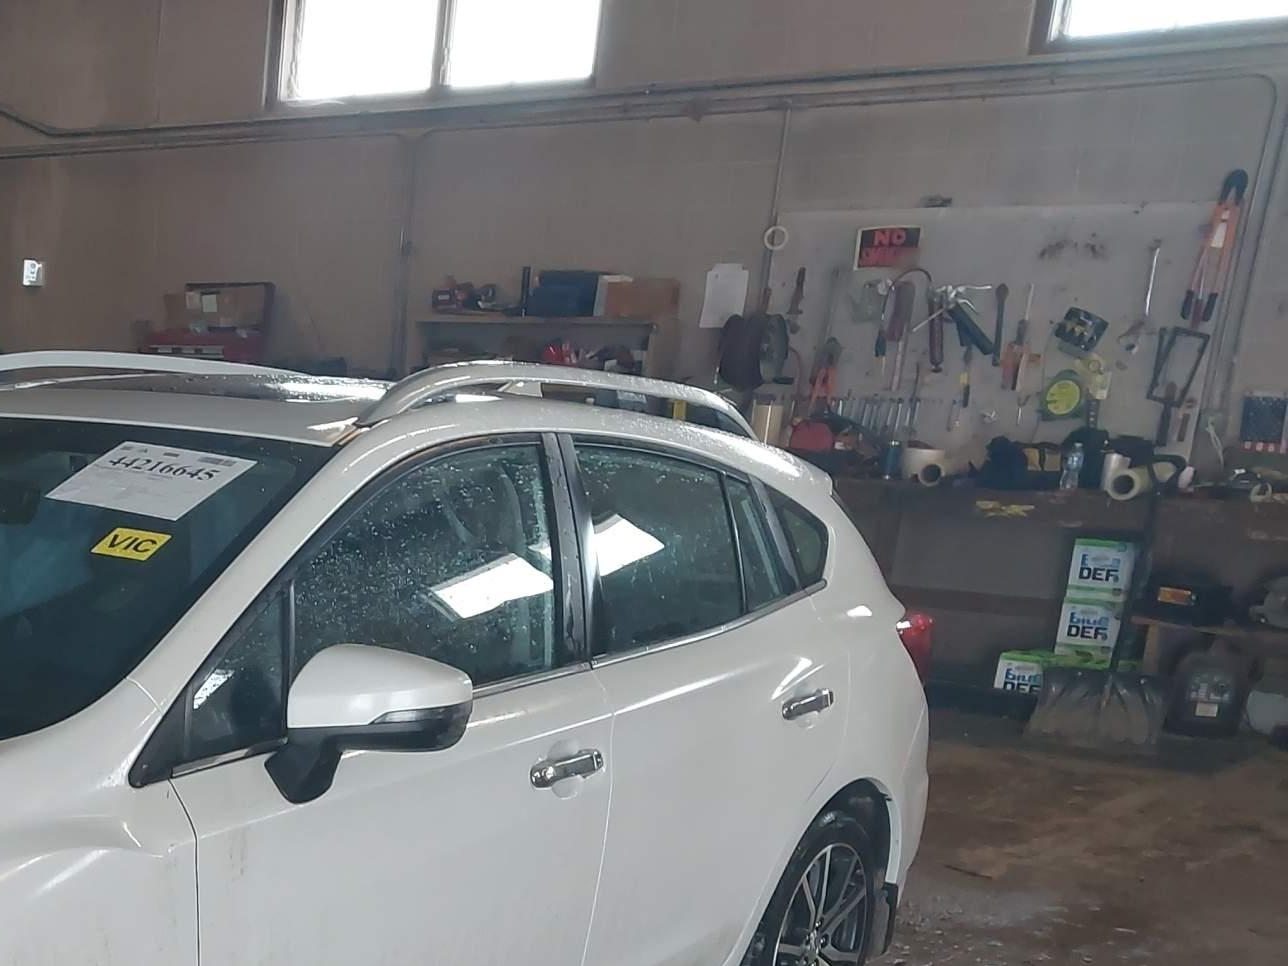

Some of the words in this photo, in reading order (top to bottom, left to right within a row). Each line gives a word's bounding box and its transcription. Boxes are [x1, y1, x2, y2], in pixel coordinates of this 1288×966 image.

[874, 230, 905, 246] NO
[108, 456, 220, 481] 44216645
[107, 534, 157, 553] VIC
[1078, 567, 1119, 583] DEF
[1067, 625, 1108, 640] DEF
